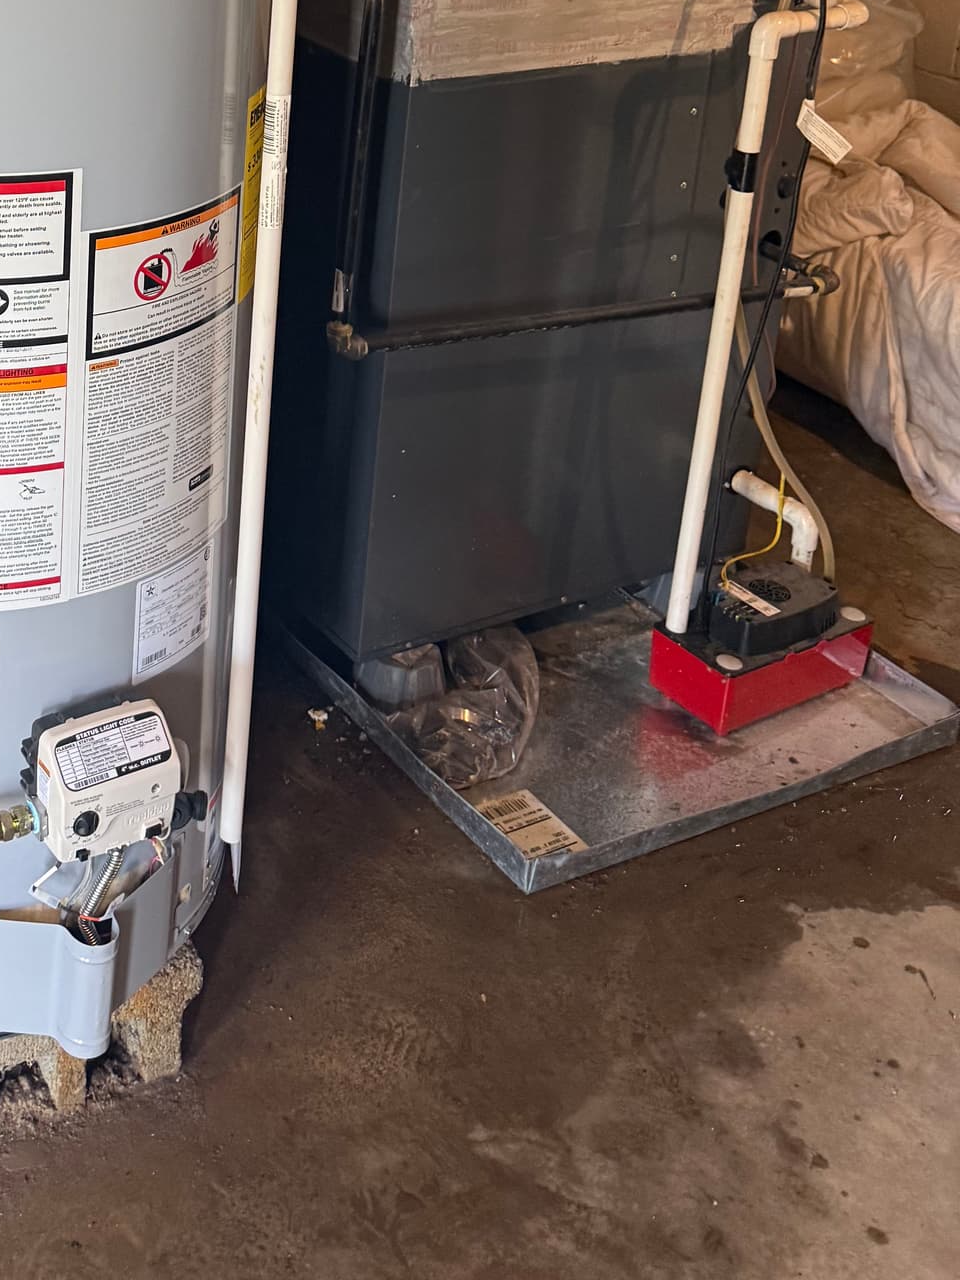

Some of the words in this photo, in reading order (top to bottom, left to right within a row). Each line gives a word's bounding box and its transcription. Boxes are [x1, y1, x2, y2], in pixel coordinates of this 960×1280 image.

[169, 216, 201, 233] WARNING
[76, 728, 99, 740] STATUS
[100, 722, 118, 732] LIGHT
[120, 716, 136, 726] CODE
[56, 743, 76, 753] FLASHES
[141, 755, 162, 766] OUTLET
